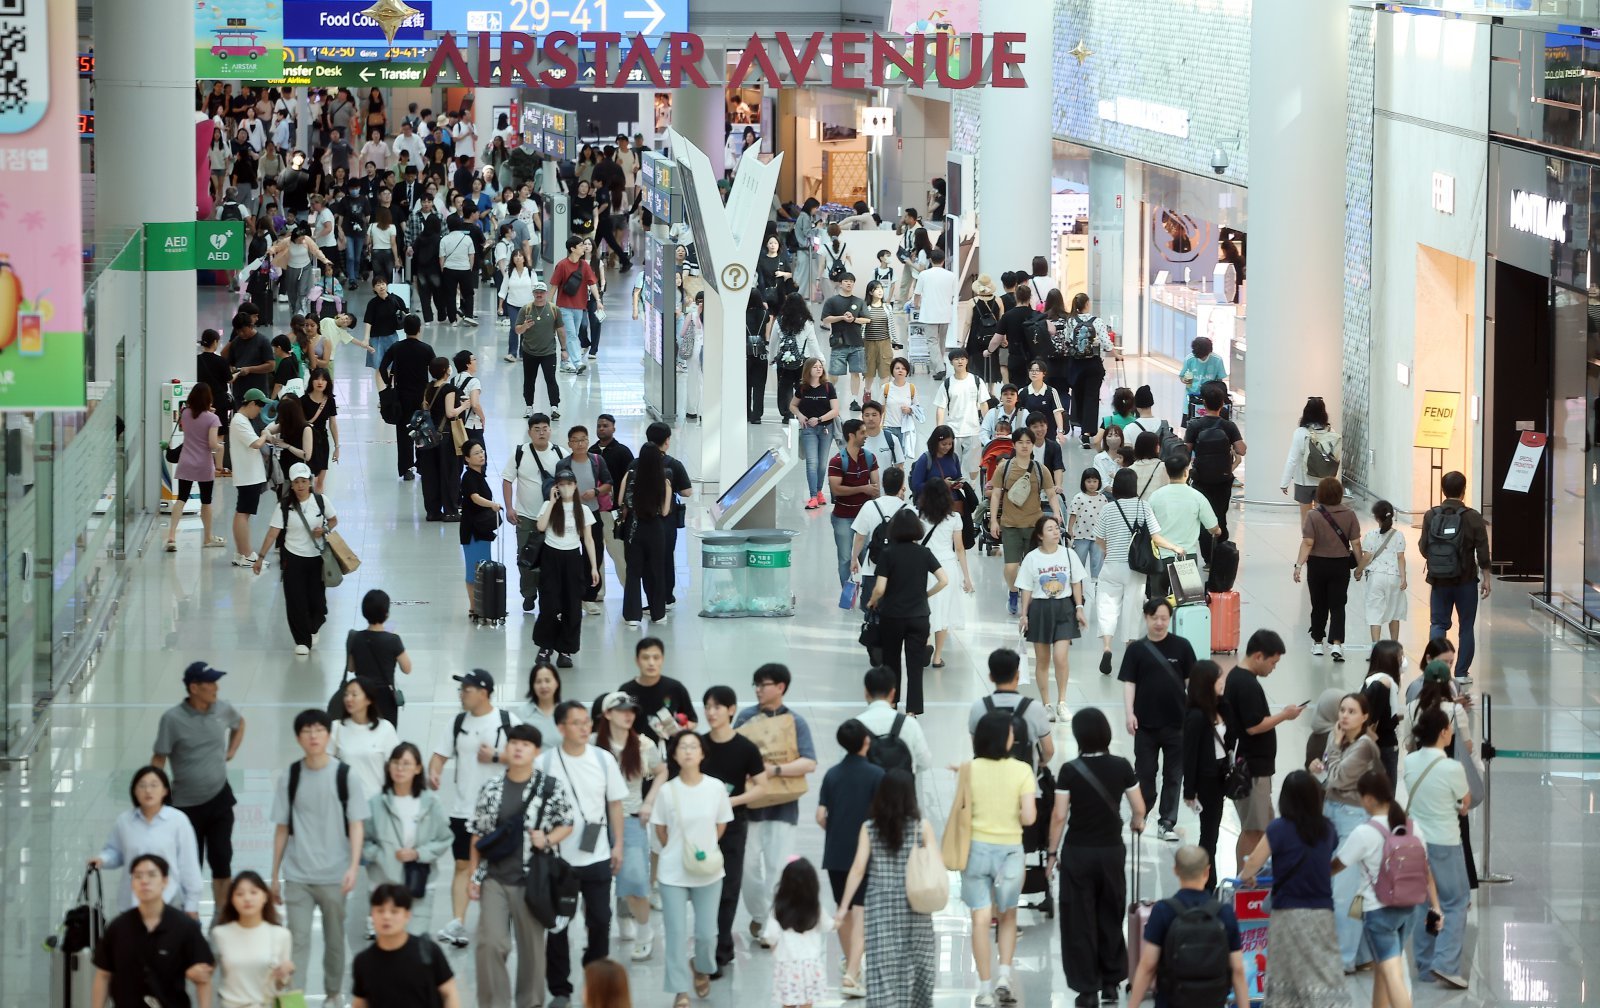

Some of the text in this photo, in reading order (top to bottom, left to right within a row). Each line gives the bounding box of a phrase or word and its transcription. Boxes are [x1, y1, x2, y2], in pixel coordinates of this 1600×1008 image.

[320, 11, 349, 26] Food
[352, 12, 379, 26] Cou
[510, 0, 608, 31] 29-41
[420, 31, 1026, 88] AIRSTAR AVENUE
[315, 65, 342, 77] Desk
[379, 67, 421, 80] Transfer
[287, 76, 311, 84] Airlines
[164, 236, 188, 248] AED
[207, 252, 230, 261] AED
[1423, 406, 1454, 419] FENDI
